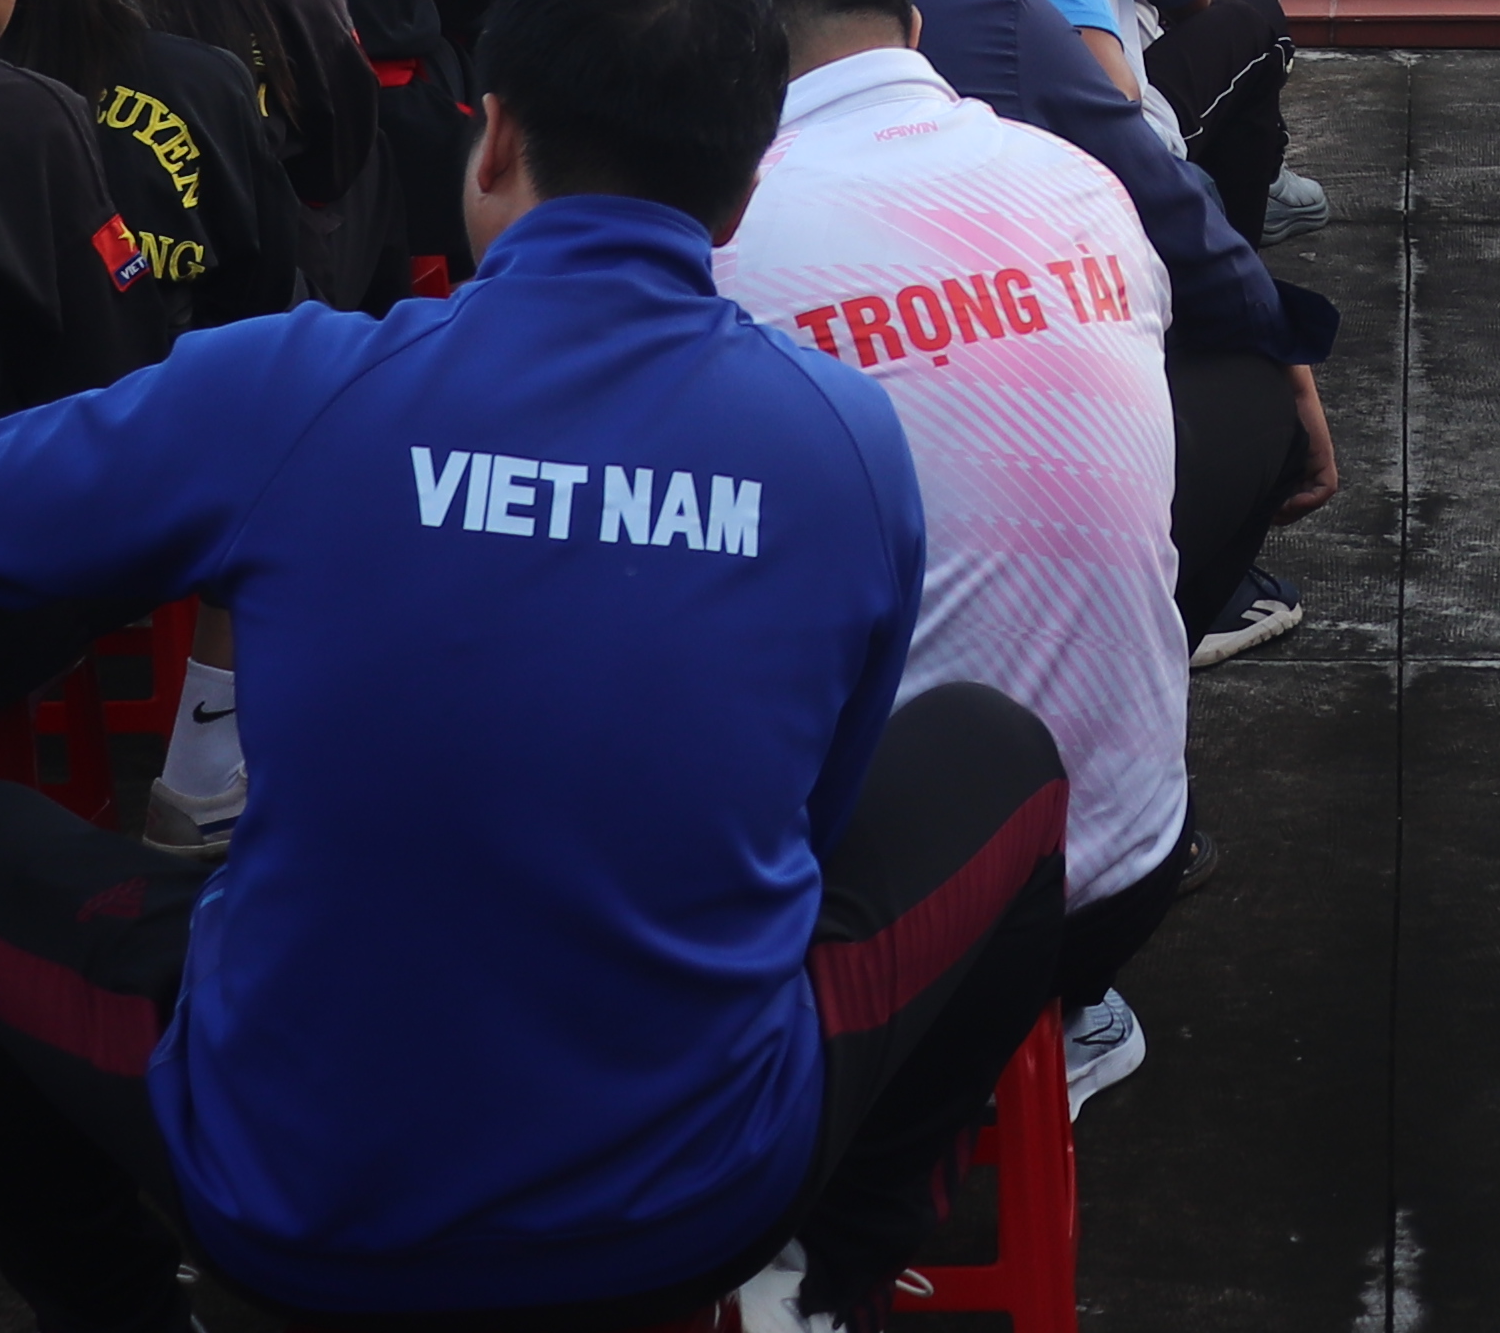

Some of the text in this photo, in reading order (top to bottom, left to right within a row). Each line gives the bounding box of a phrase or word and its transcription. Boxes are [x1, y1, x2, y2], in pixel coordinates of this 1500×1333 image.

[794, 242, 1132, 367] TRỌNG TÀI
[410, 445, 764, 559] VIET NAM
